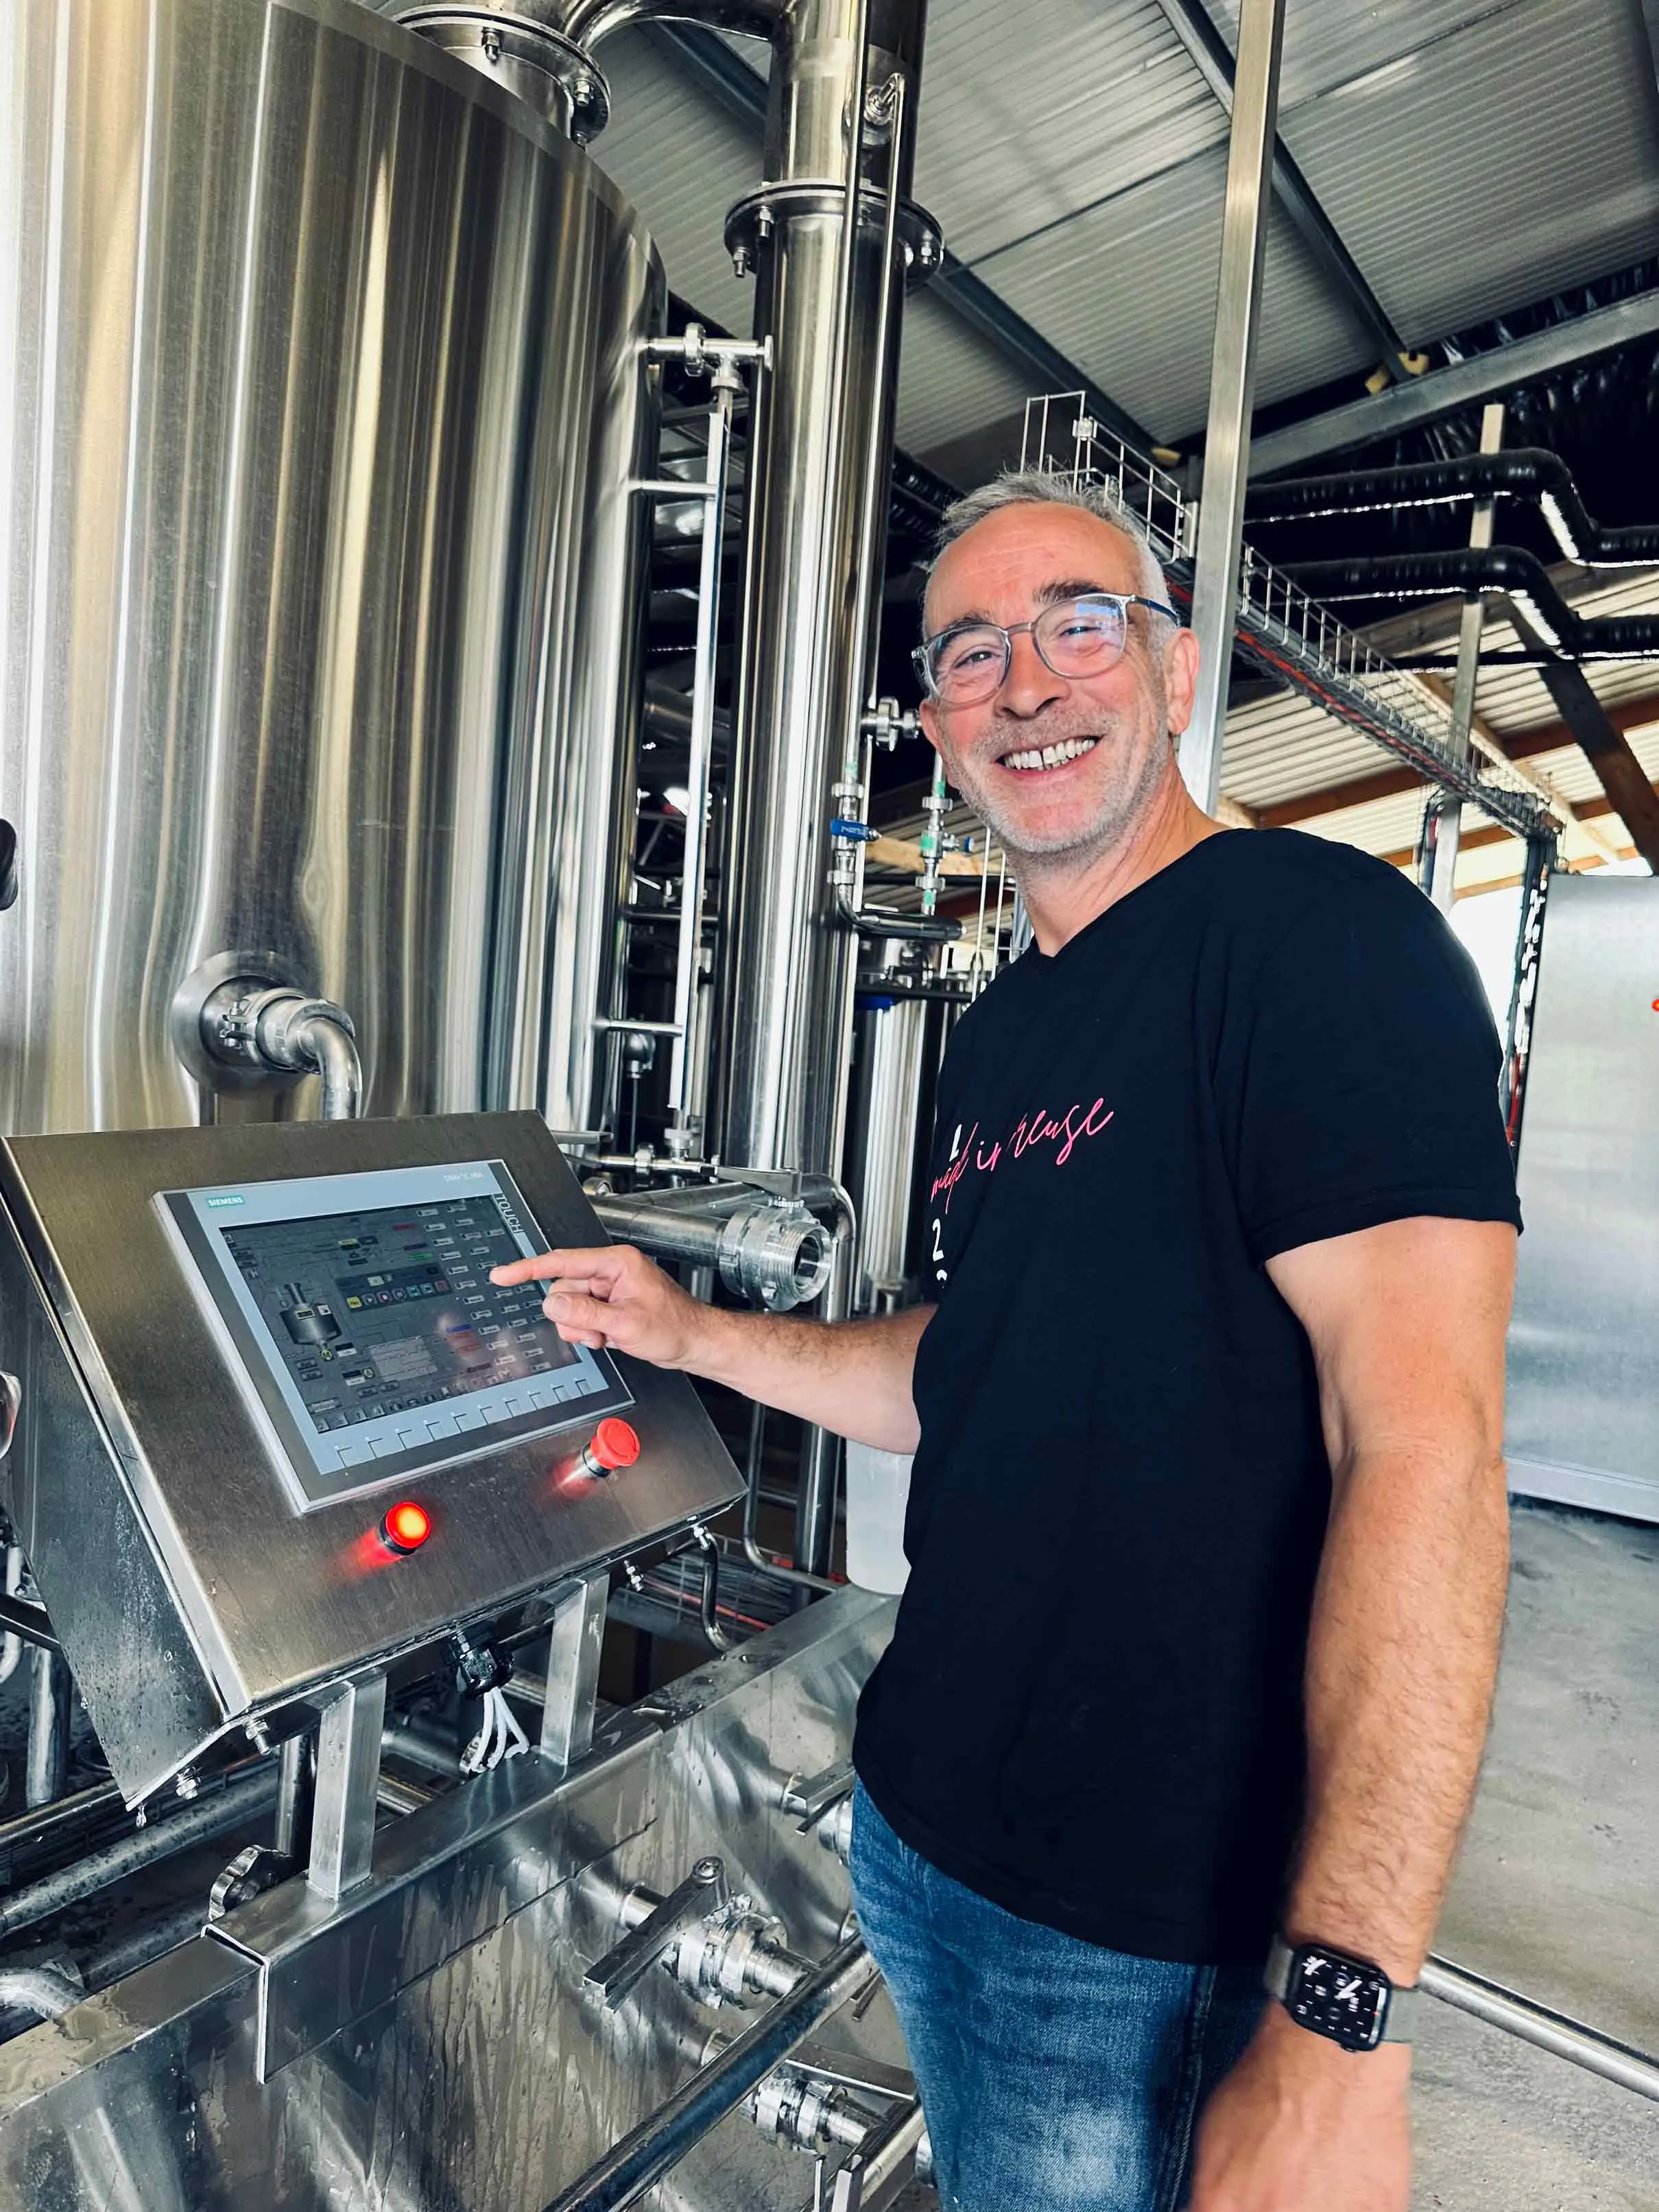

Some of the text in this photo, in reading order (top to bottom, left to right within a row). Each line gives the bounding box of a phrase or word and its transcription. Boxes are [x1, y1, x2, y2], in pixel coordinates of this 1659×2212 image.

[976, 1141, 1002, 1172] in
[208, 1197, 243, 1206] SIEMENS
[497, 1194, 523, 1233] TOUCH
